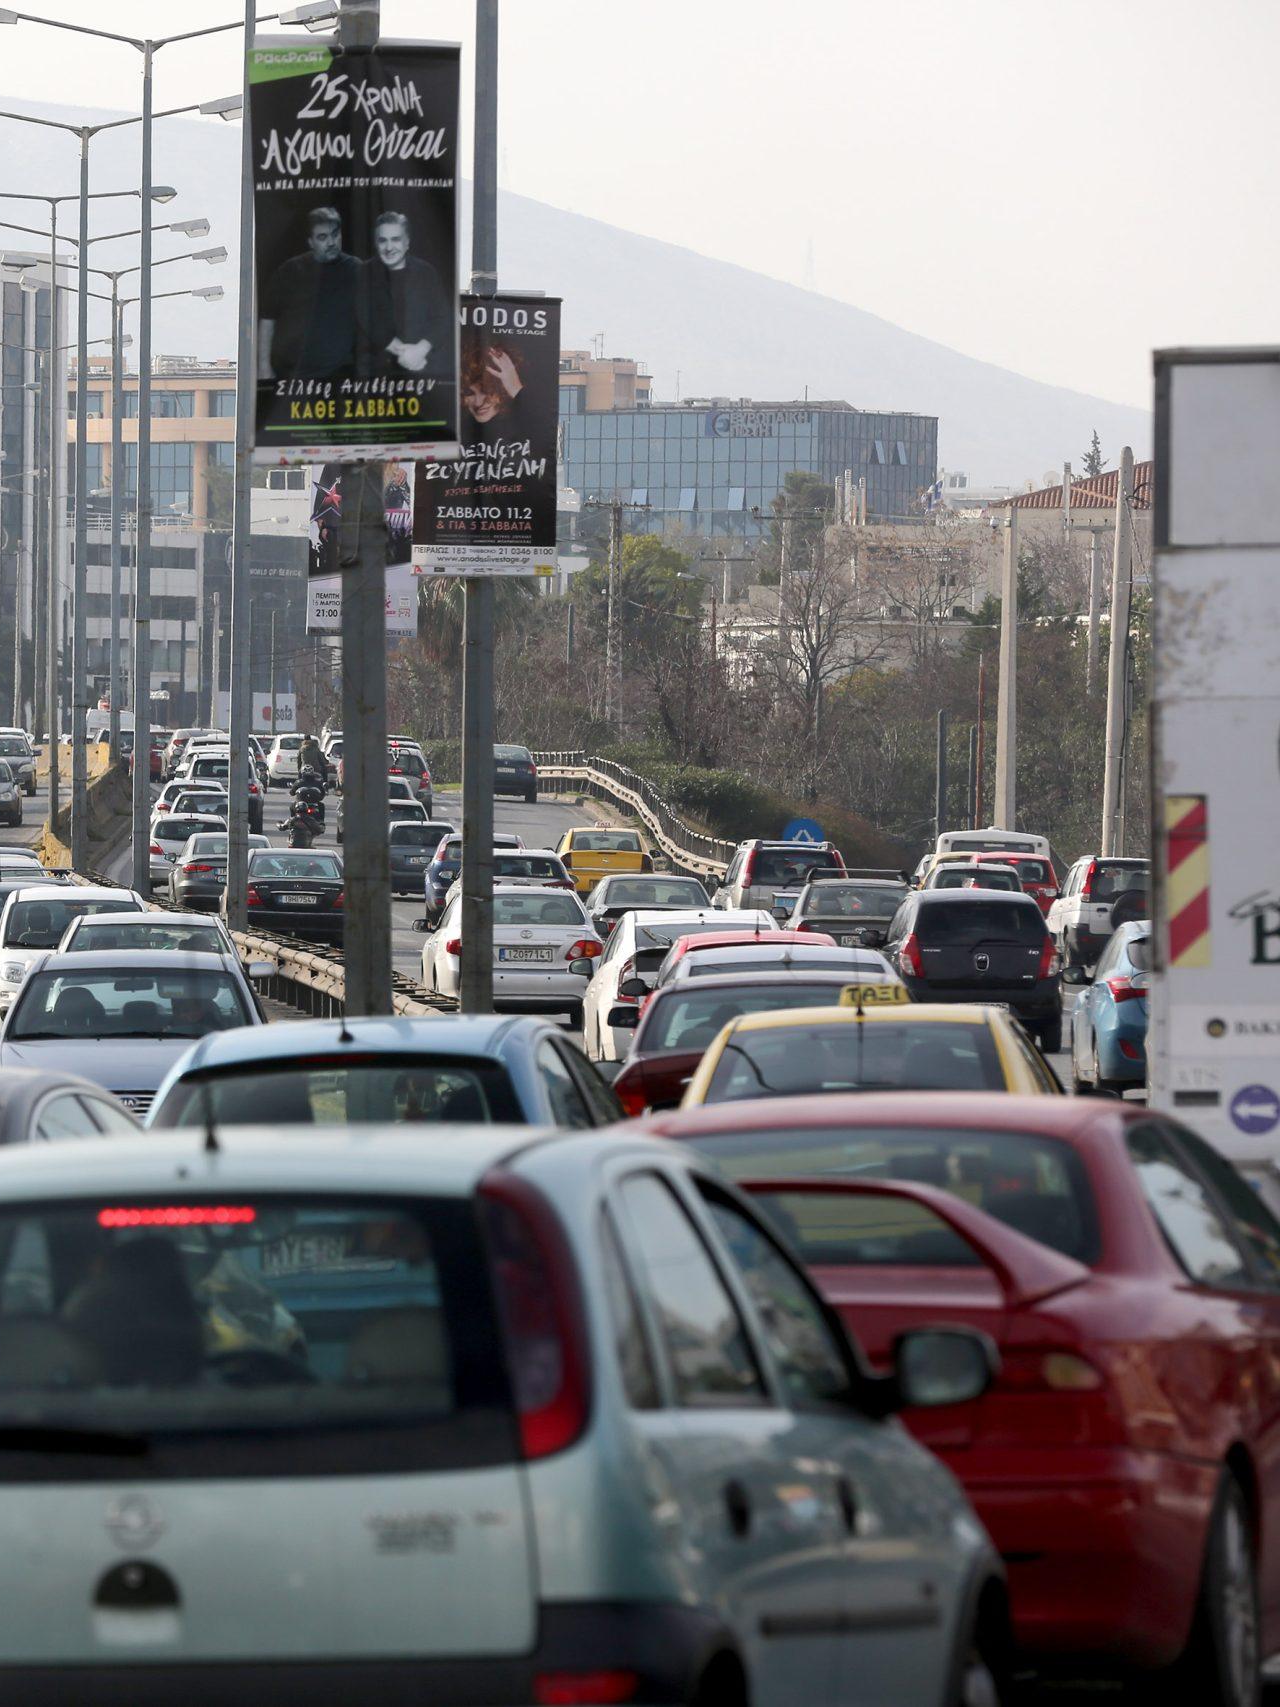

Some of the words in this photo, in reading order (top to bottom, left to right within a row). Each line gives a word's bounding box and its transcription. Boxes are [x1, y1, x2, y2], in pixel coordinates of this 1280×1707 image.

[296, 73, 349, 120] 25
[290, 400, 336, 419] ΚΑΘΕ
[344, 397, 420, 418] ΣΑΒΒΑΤΟ
[436, 506, 501, 519] ΣΑΒΒΑΤΟ
[507, 507, 532, 520] 11.2
[448, 521, 466, 530] ΓΙΑ
[480, 521, 532, 531] ΣΑΒΒΑΤΑ
[315, 609, 338, 618] 21:00
